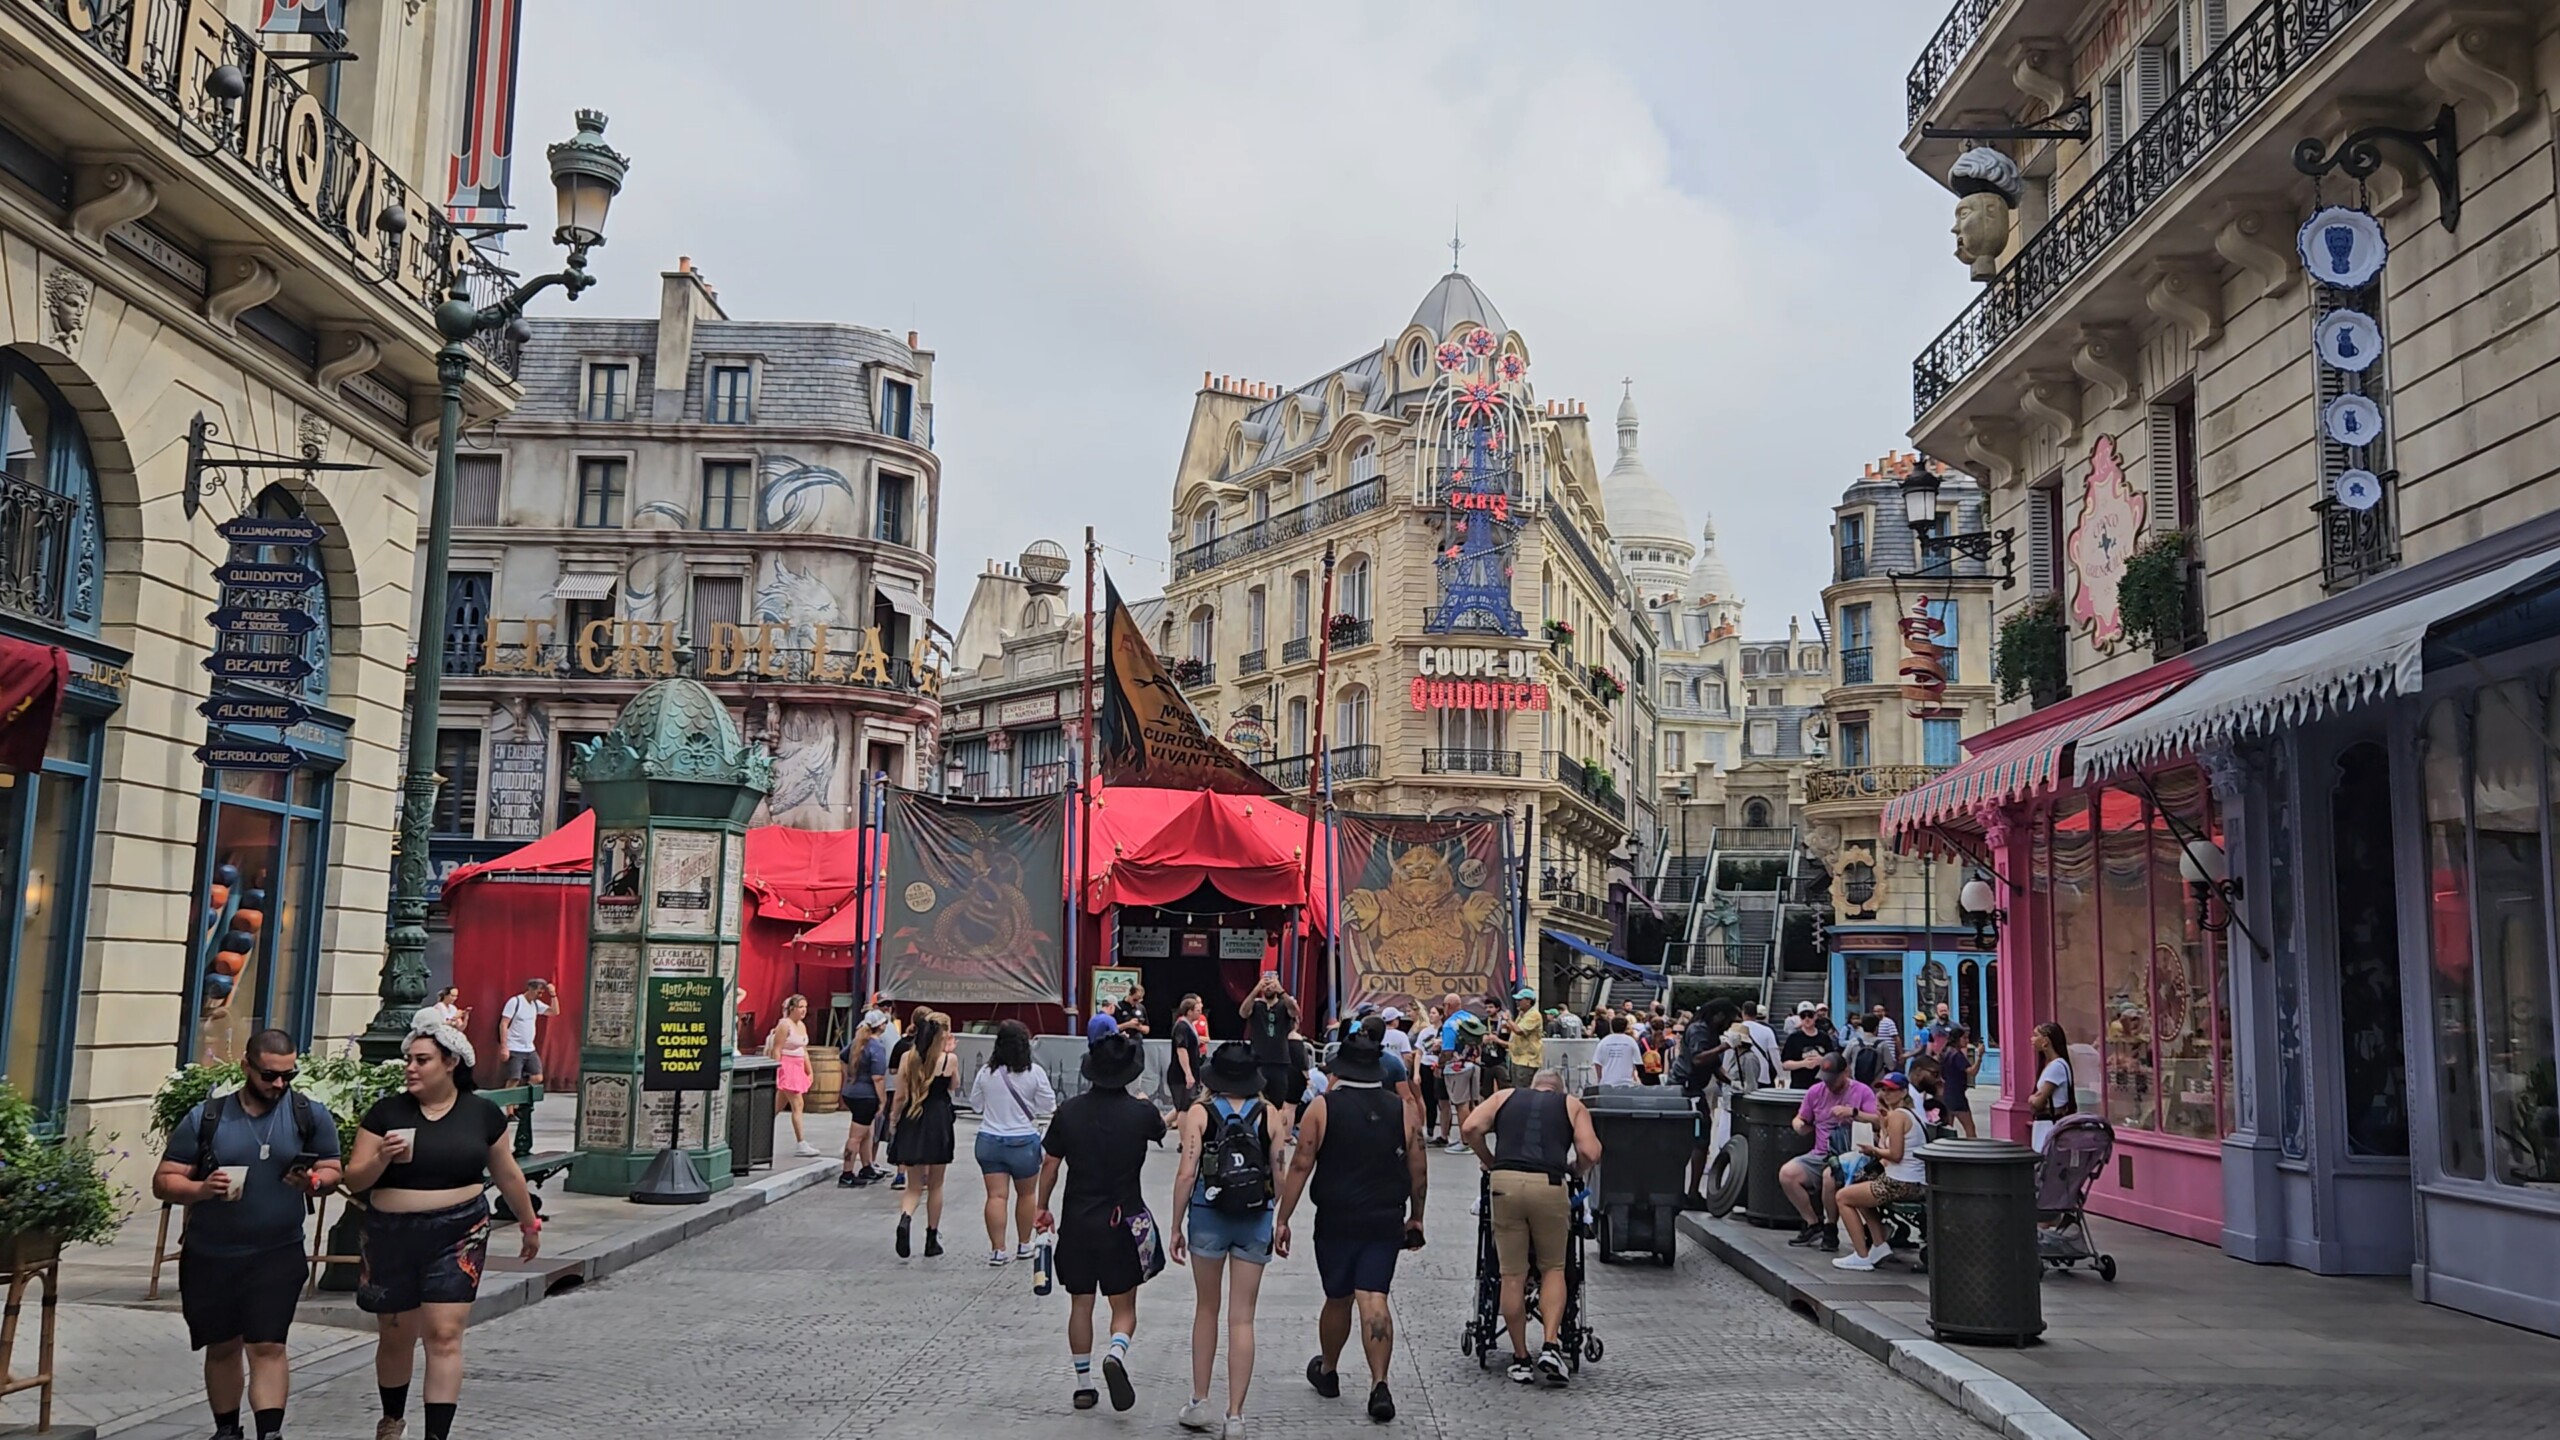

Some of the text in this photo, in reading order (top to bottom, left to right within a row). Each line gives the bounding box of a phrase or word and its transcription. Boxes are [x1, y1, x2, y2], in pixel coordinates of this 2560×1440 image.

[1452, 491, 1508, 511] PARIS
[229, 526, 313, 538] ILLUMINATIONS
[230, 570, 303, 583] QUIDDITCH
[241, 611, 280, 622] ROBES
[231, 621, 248, 630] DE
[480, 614, 557, 677] LE
[576, 617, 680, 678] CRI
[704, 617, 792, 681] DE
[808, 620, 894, 687] LA
[225, 658, 291, 673] BEAUTÉ
[1419, 646, 1540, 678] COUPE DE
[1410, 675, 1547, 712] QUIDDITCH
[217, 702, 290, 718] ALCHIMIE
[209, 751, 291, 763] HERBOLOGIE
[494, 744, 545, 760] EN EXCLUSIF
[1151, 745, 1235, 769] VIVANTES
[492, 772, 543, 792] QUIDDITCH
[500, 790, 532, 804] POTIONS
[500, 805, 532, 818] CULTURE
[489, 818, 540, 836] FAITS DIVERS
[1225, 941, 1261, 949] ATTRACTION
[600, 966, 630, 979] MAGIQUE
[659, 981, 712, 999] Harry Potter
[1369, 976, 1406, 993] ONI
[1414, 974, 1434, 994] 鬼
[1441, 977, 1480, 994] ONI
[660, 1022, 706, 1033] WILL BE
[656, 1035, 708, 1046] CLOSING
[663, 1048, 700, 1059] EARLY
[660, 1061, 702, 1072] TODAY
[1230, 1152, 1245, 1167] D
